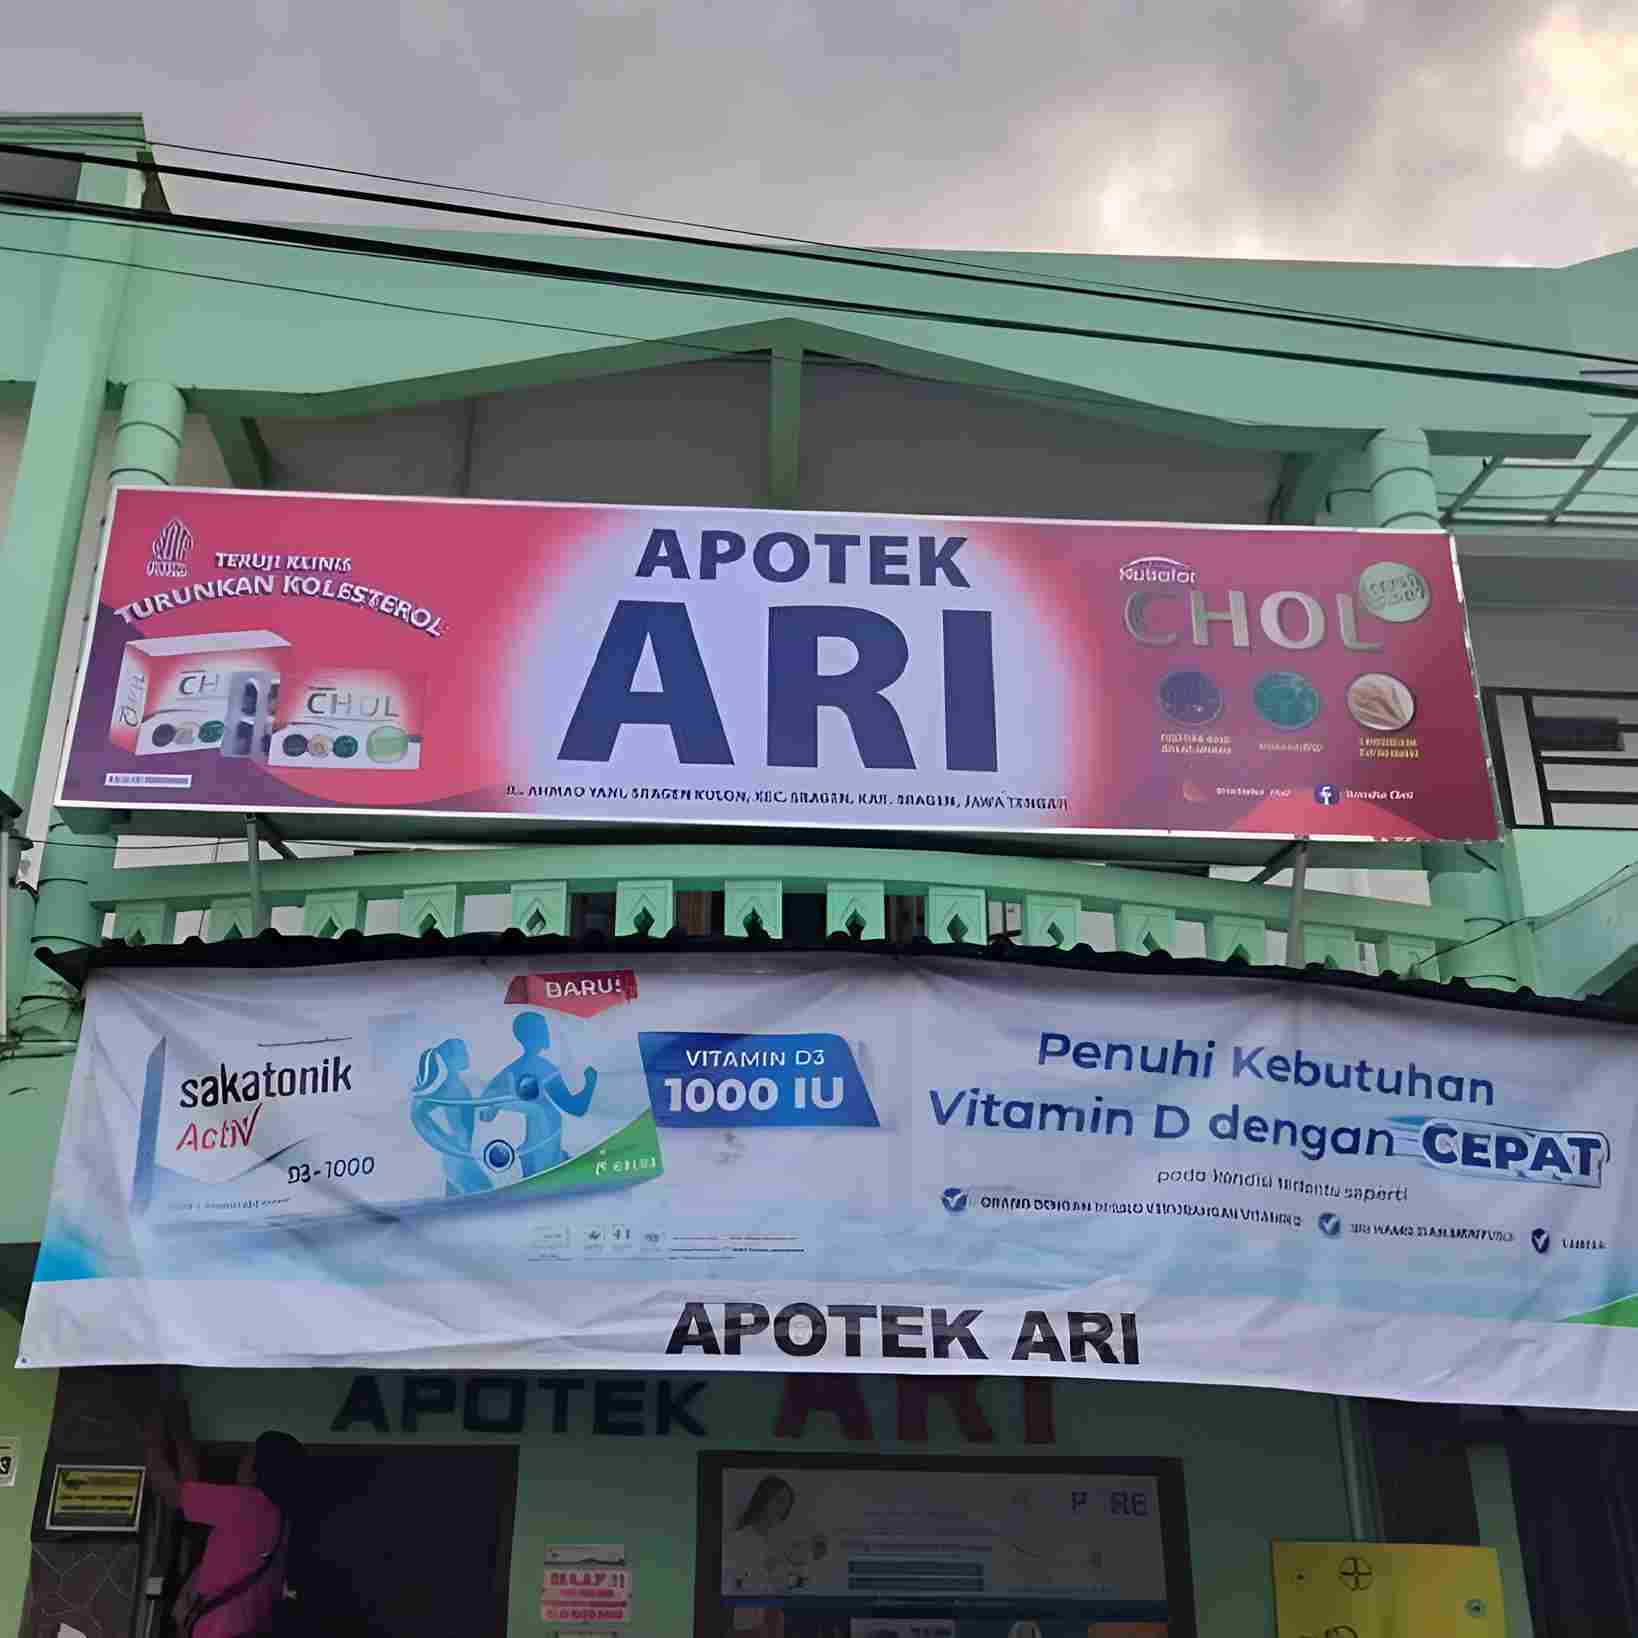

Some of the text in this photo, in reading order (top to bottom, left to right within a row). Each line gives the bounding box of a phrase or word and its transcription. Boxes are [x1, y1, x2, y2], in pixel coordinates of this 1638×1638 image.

[215, 551, 281, 570] TERUJI
[634, 528, 971, 588] APOTEK
[114, 575, 445, 638] TURUNKAN KOLESTEROL
[1123, 589, 1384, 651] CHOL
[556, 599, 999, 773] ARI
[545, 976, 622, 999] BARU!
[179, 1055, 352, 1108] sakatonik
[685, 1048, 825, 1068] VITAMIN D3
[1037, 1031, 1495, 1106] Penuhi Kebutuhan
[663, 1076, 844, 1113] 1000 IU
[929, 1087, 1602, 1177] Vitamin D dengan CEPAT
[287, 1156, 376, 1184] D3-1000
[664, 1301, 1141, 1365] APOTEK ARI
[331, 1374, 708, 1437] APOTEK
